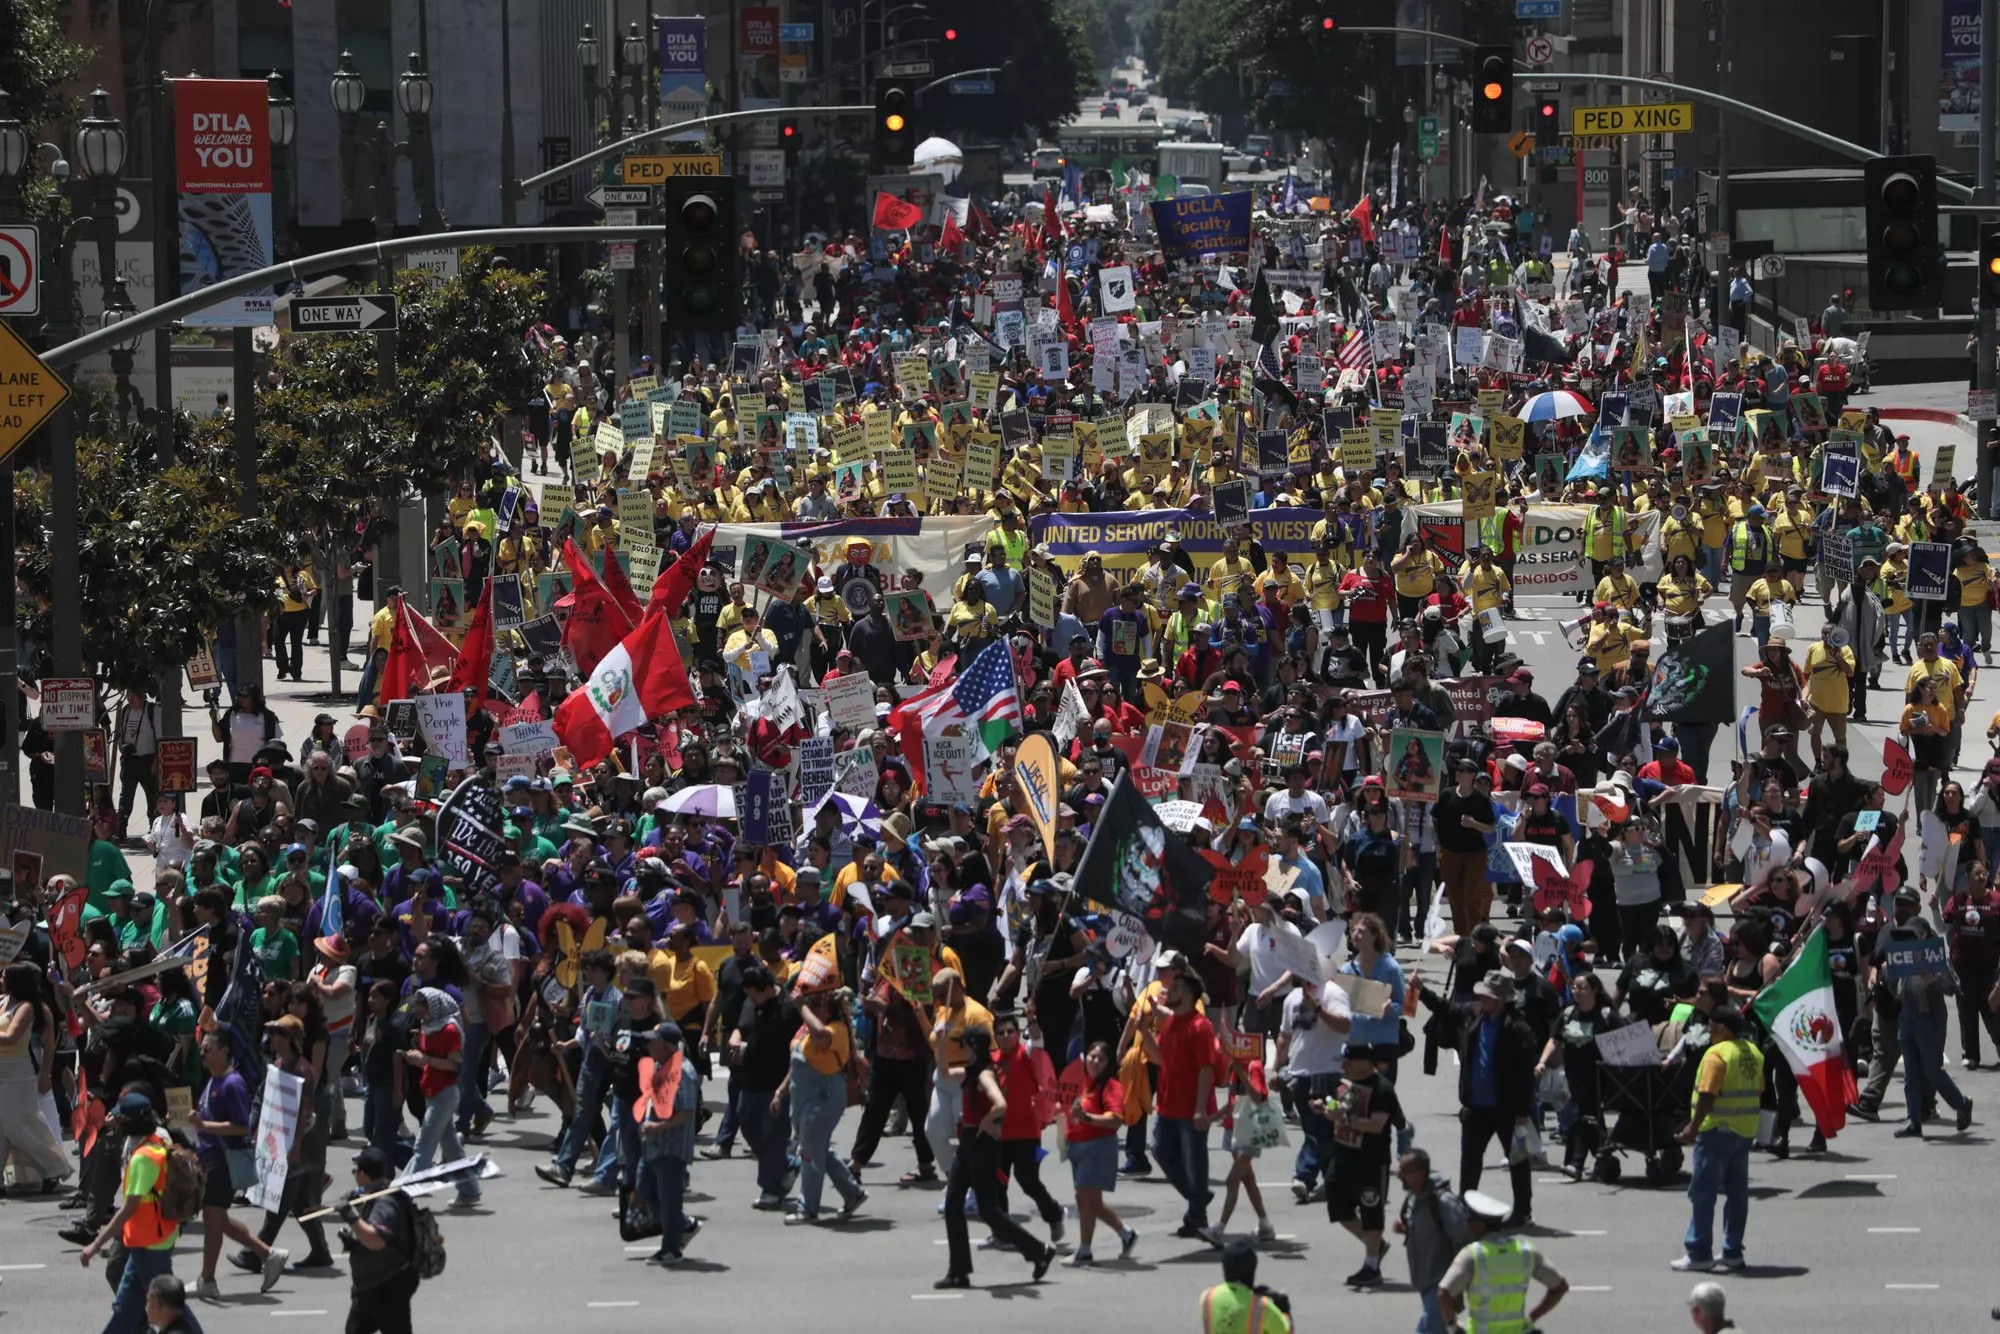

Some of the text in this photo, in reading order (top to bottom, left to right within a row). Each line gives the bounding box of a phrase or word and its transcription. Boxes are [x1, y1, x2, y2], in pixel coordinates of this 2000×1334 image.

[1543, 4, 1554, 13] St
[748, 22, 771, 30] DTLA
[1951, 16, 1981, 26] DTLA
[668, 34, 696, 44] DTLA
[750, 36, 773, 44] YOU
[1952, 35, 1981, 45] YOU
[669, 51, 697, 62] YOU
[912, 64, 928, 72] WAY
[193, 113, 252, 131] DTLA
[1584, 109, 1681, 129] PED XING
[194, 134, 252, 145] WELCOMES
[195, 148, 253, 168] YOU
[630, 162, 713, 178] PED XING
[1585, 170, 1608, 183] 800
[604, 192, 645, 201] ONE WAY
[1176, 198, 1224, 216] UCLA
[1174, 218, 1231, 235] Faculty
[418, 262, 446, 272] MUST
[994, 280, 1022, 290] STOP
[302, 307, 362, 322] ONE WAY
[1033, 338, 1056, 346] STRIKE
[9, 395, 45, 407] LEFT
[1100, 426, 1122, 434] PUEBLO
[838, 435, 862, 447] PUEBLO
[1106, 446, 1127, 454] PUEBLO
[1290, 448, 1310, 460] LAX
[969, 456, 991, 465] PUEBLO
[930, 469, 955, 478] PUEBLO
[968, 478, 990, 487] PUEBLO
[929, 488, 952, 496] PUEBLO
[1826, 484, 1851, 493] JANITORS
[1220, 514, 1245, 523] JANITORS
[625, 527, 643, 537] SOLO
[1042, 525, 1100, 544] UNITED
[632, 544, 650, 553] SOLO
[1824, 542, 1851, 553] STAND UP
[1832, 550, 1852, 560] TRUMP
[630, 556, 656, 567] PUEBLO
[1825, 555, 1852, 570] GENERAL
[1512, 571, 1578, 585] ENCIDOS
[700, 605, 718, 614] LICE
[44, 692, 90, 702] NO STOPPING
[46, 704, 90, 714] ANY TIME
[416, 698, 454, 710] We the
[1157, 702, 1187, 718] PROTECT
[424, 713, 460, 732] People
[434, 732, 452, 741] are
[509, 725, 543, 739] THINK
[1277, 733, 1301, 745] ICE
[936, 741, 953, 749] KICK
[802, 748, 832, 760] STAND UP
[934, 750, 966, 759] ICE OUT!
[812, 759, 834, 770] TRUMP
[802, 771, 835, 785] GENERAL
[771, 788, 784, 798] UP
[452, 819, 477, 846] We
[1888, 951, 1913, 965] ICE
